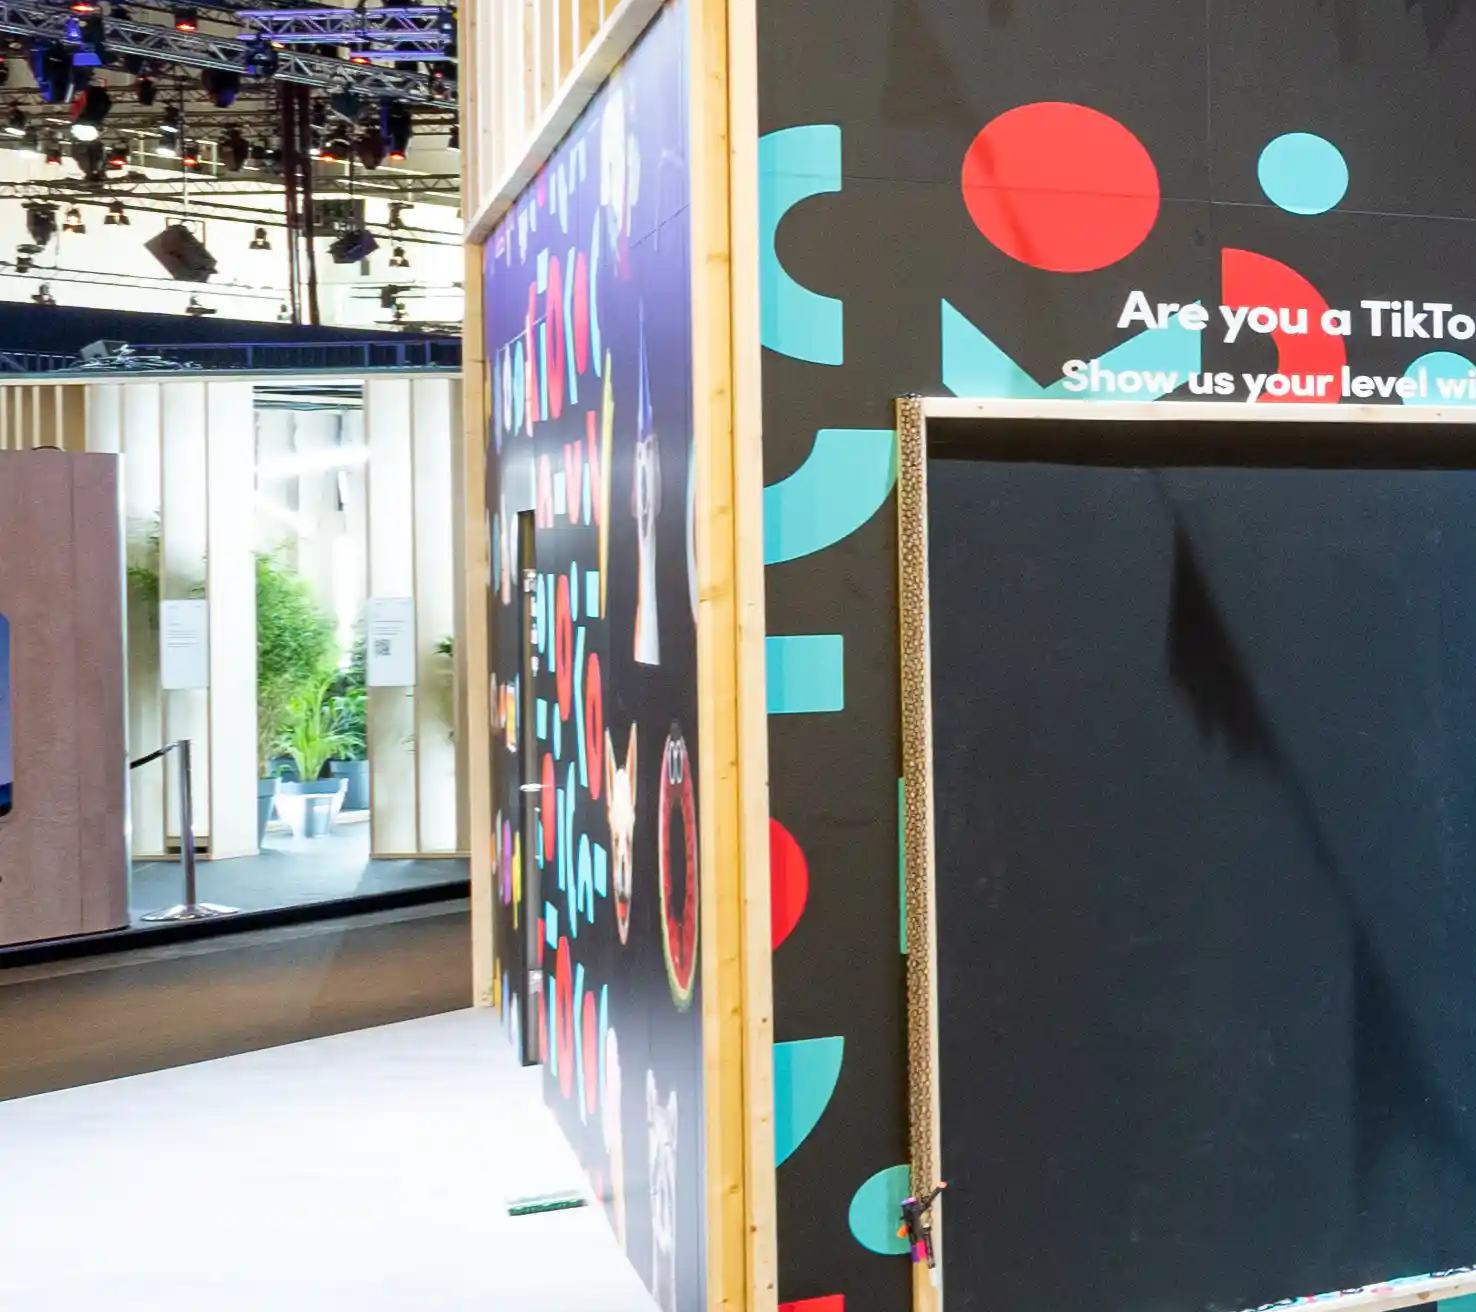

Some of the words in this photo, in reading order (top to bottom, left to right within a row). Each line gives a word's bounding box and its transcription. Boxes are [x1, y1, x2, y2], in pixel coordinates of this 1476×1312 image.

[1117, 290, 1211, 331] Are
[1219, 301, 1309, 344] you
[1321, 308, 1352, 337] a
[1062, 359, 1181, 396] Show
[1189, 371, 1235, 398] us
[1243, 372, 1335, 405] your
[1341, 366, 1427, 400] level
